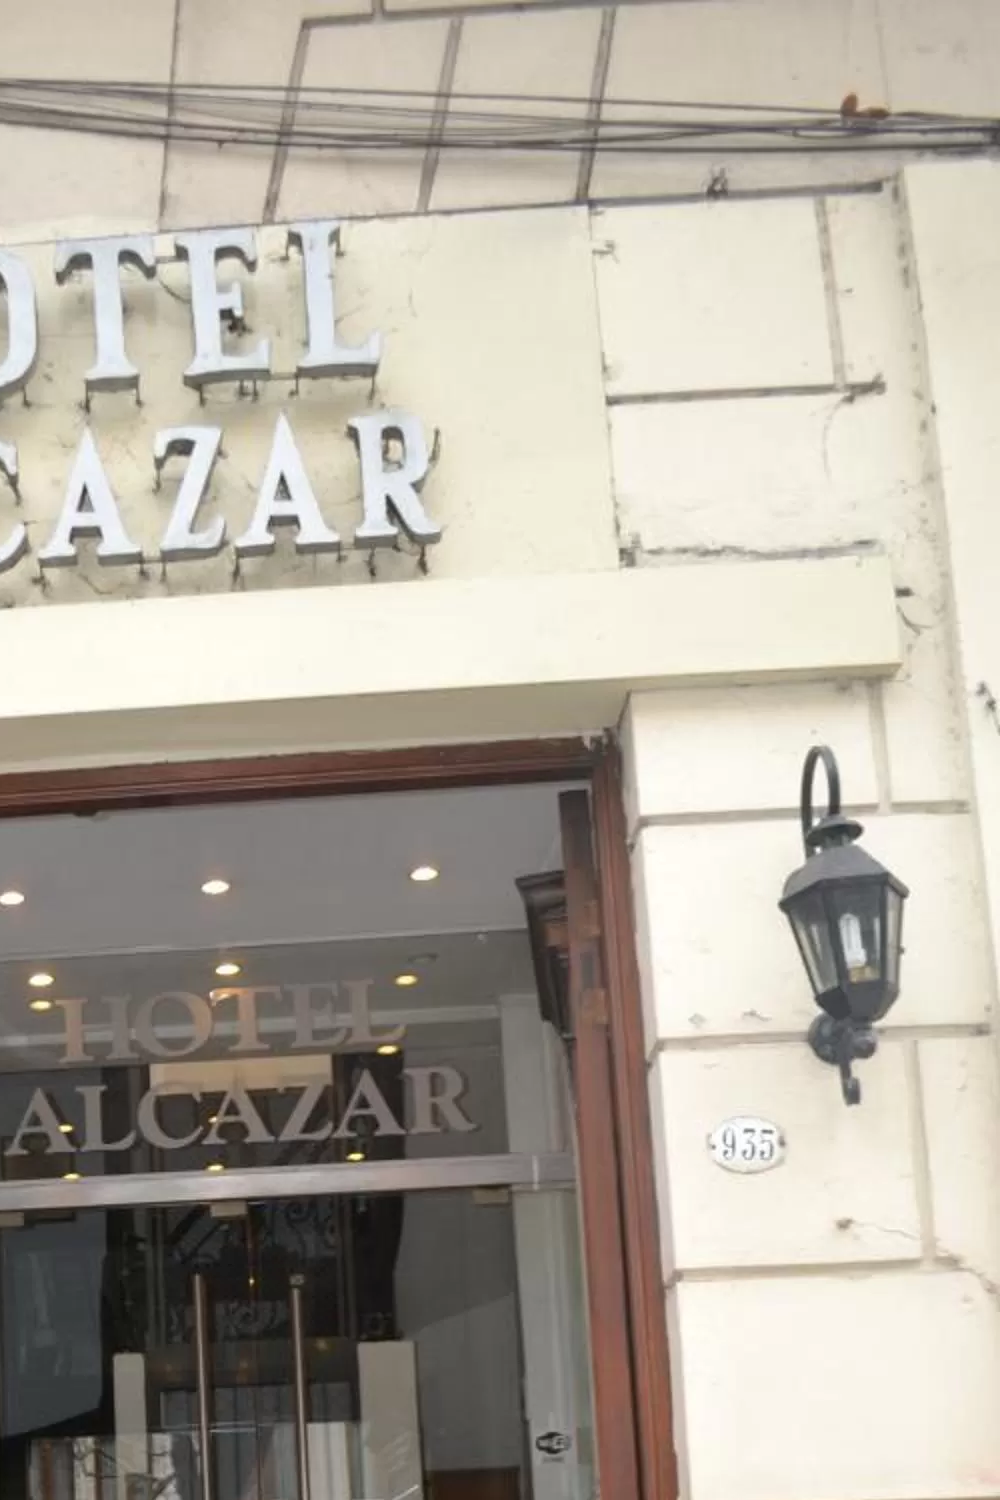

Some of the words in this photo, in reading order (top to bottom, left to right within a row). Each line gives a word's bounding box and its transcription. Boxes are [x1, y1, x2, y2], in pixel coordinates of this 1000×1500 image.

[55, 979, 406, 1064] HOTEL
[4, 1063, 479, 1156] ALCAZAR
[721, 1126, 775, 1161] 935
